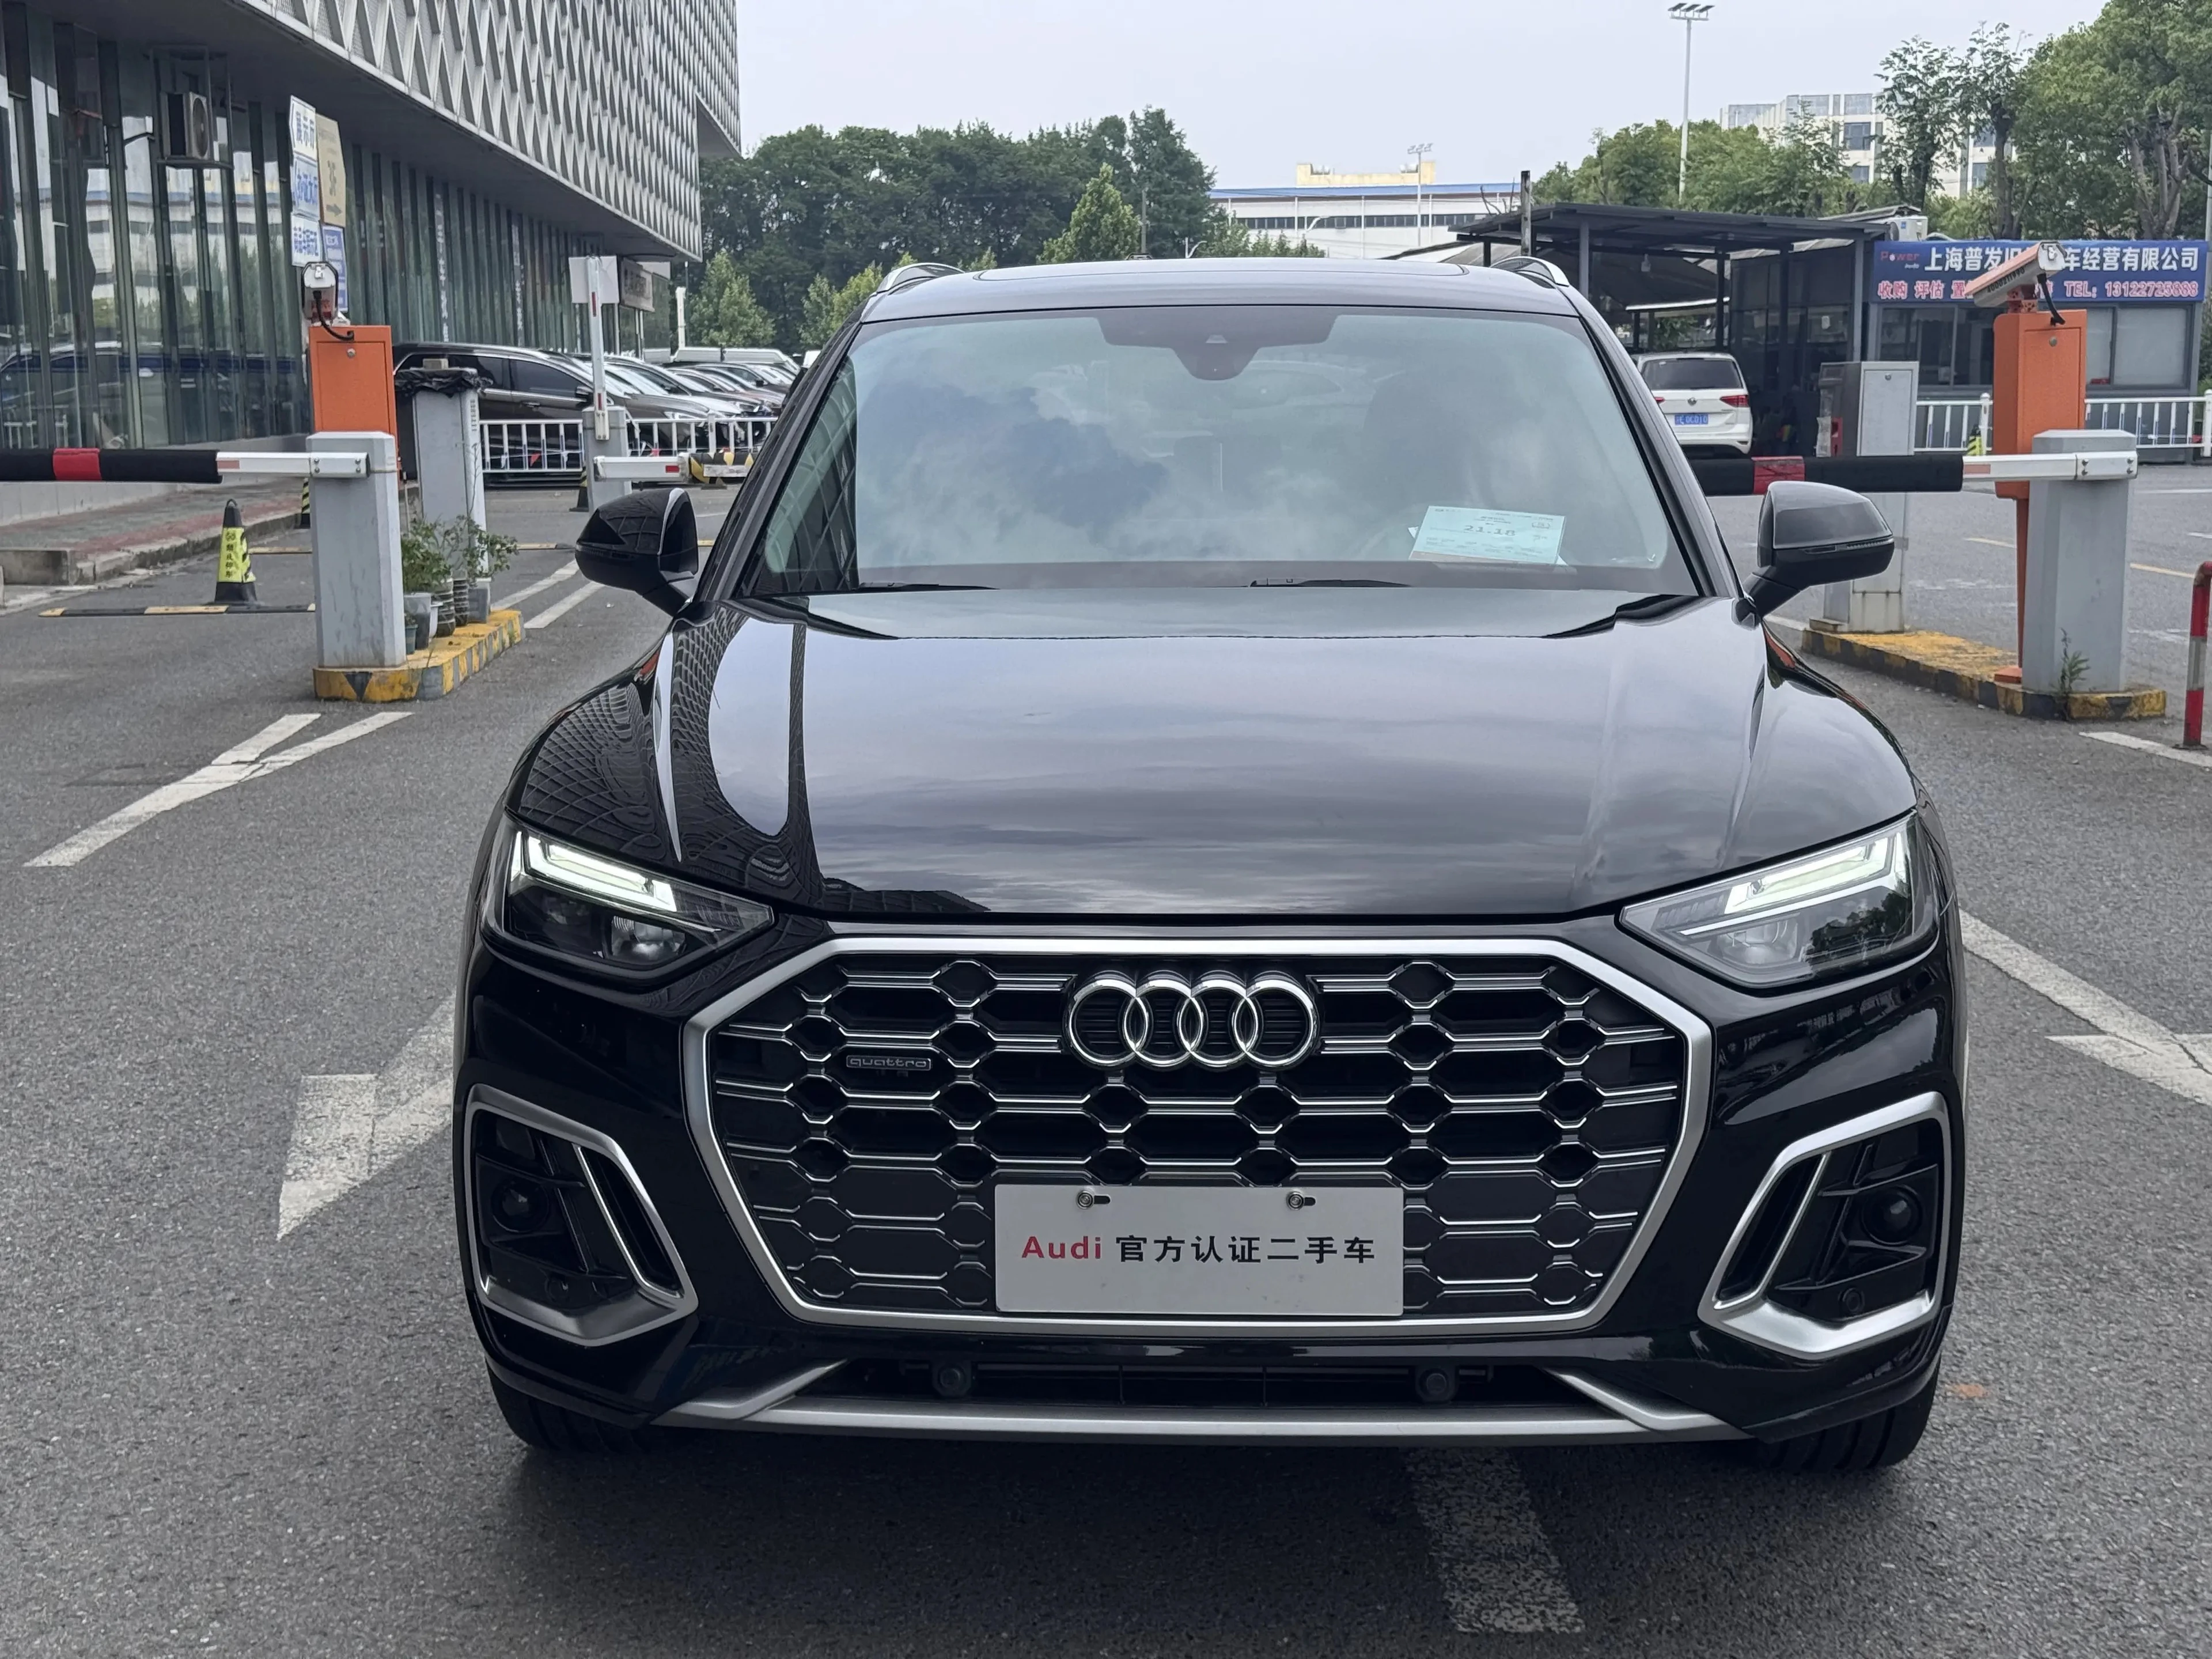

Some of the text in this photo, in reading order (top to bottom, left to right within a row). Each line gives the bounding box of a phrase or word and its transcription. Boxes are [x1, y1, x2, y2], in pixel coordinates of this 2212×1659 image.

[1925, 247, 2199, 271] 上海普发旧车经营有限公司
[1878, 280, 1907, 300] 收购
[1914, 280, 1945, 300] 评估
[1950, 280, 1974, 300] 置
[850, 1058, 927, 1067] quattro
[1022, 1234, 1375, 1264] Audi 官方认证二手车
